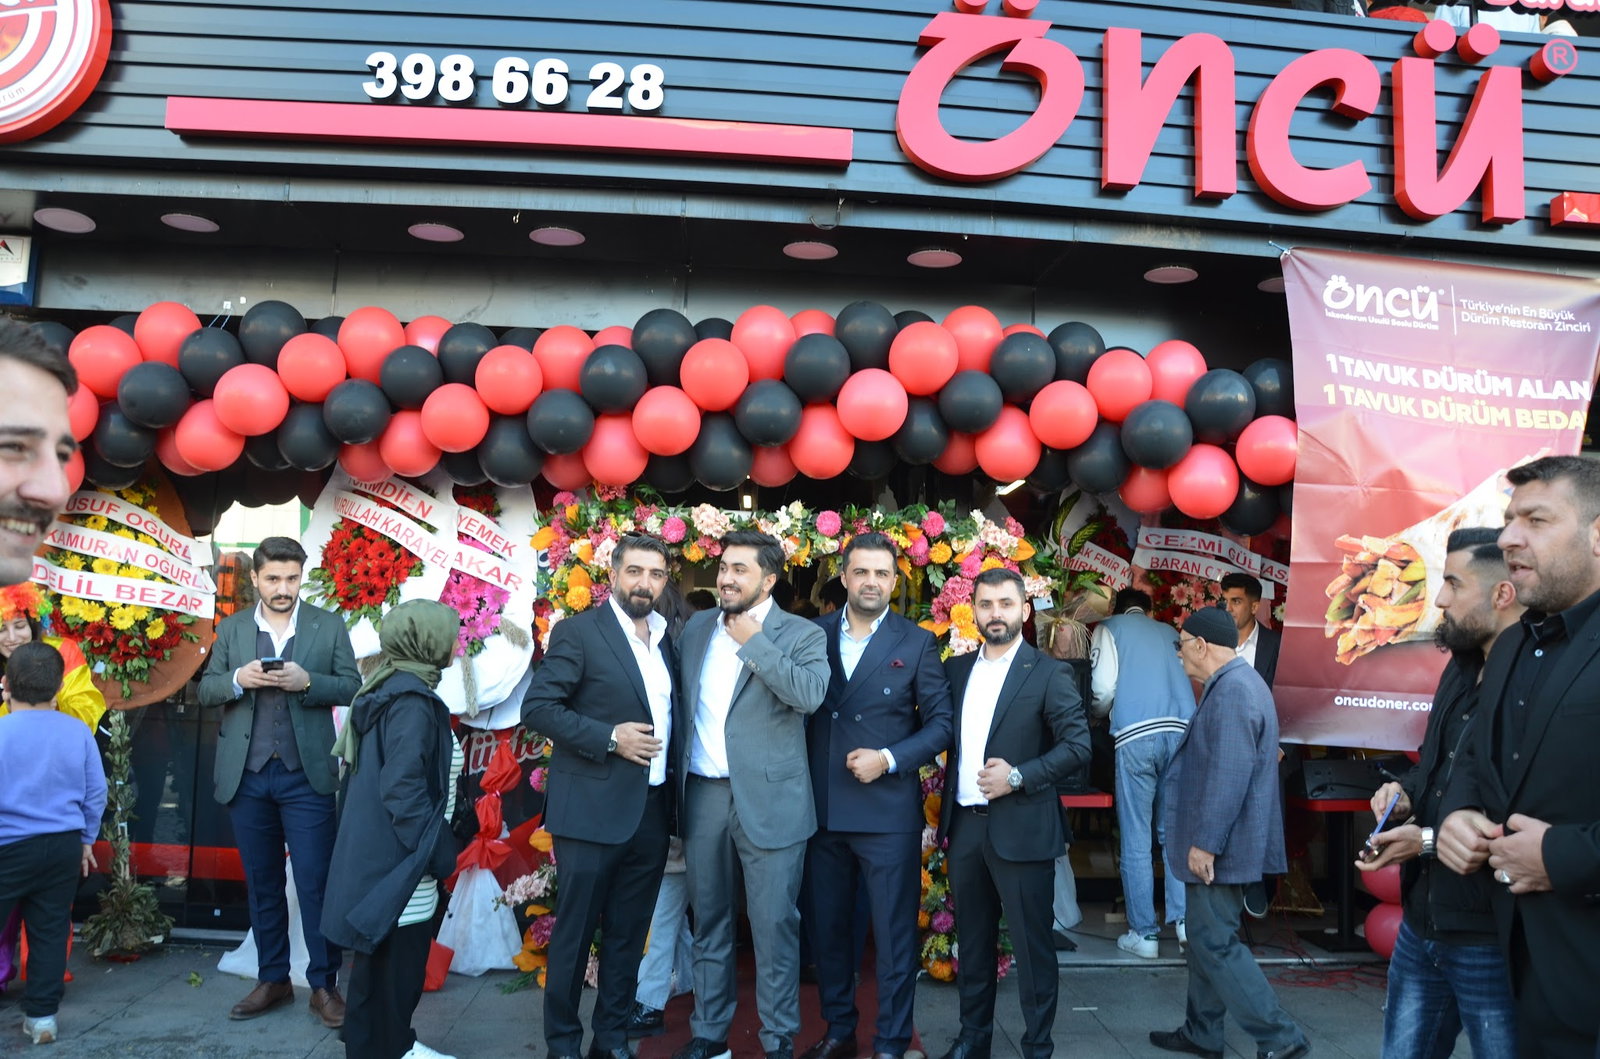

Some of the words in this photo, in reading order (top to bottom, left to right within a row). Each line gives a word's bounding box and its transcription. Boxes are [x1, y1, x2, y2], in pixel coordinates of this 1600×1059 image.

[362, 51, 475, 102] 398
[491, 56, 569, 105] 66
[586, 62, 665, 111] 28
[1460, 299, 1521, 316] Türkiye'nin
[1522, 306, 1537, 318] En
[1540, 308, 1575, 322] Büyük
[1461, 311, 1500, 326] Dürüm
[1502, 315, 1553, 331] Restoran
[1554, 321, 1591, 333] Zinciri
[1326, 353, 1338, 374] 1
[1339, 355, 1420, 388] TAVUK
[1422, 365, 1513, 398] DÜRÜM
[1517, 378, 1591, 402] ALAN
[1323, 383, 1336, 405] 1
[1339, 384, 1419, 418] TAVUK
[1420, 395, 1512, 428] DÜRÜM
[1515, 408, 1587, 431] BEDA
[65, 497, 121, 515] USUF
[126, 512, 192, 561] OĞURL
[380, 515, 449, 569] KARAYEL
[457, 513, 518, 558] YEMEK
[31, 563, 103, 597] DELİL
[115, 584, 204, 612] BEZAR
[1150, 556, 1201, 575] BARAN
